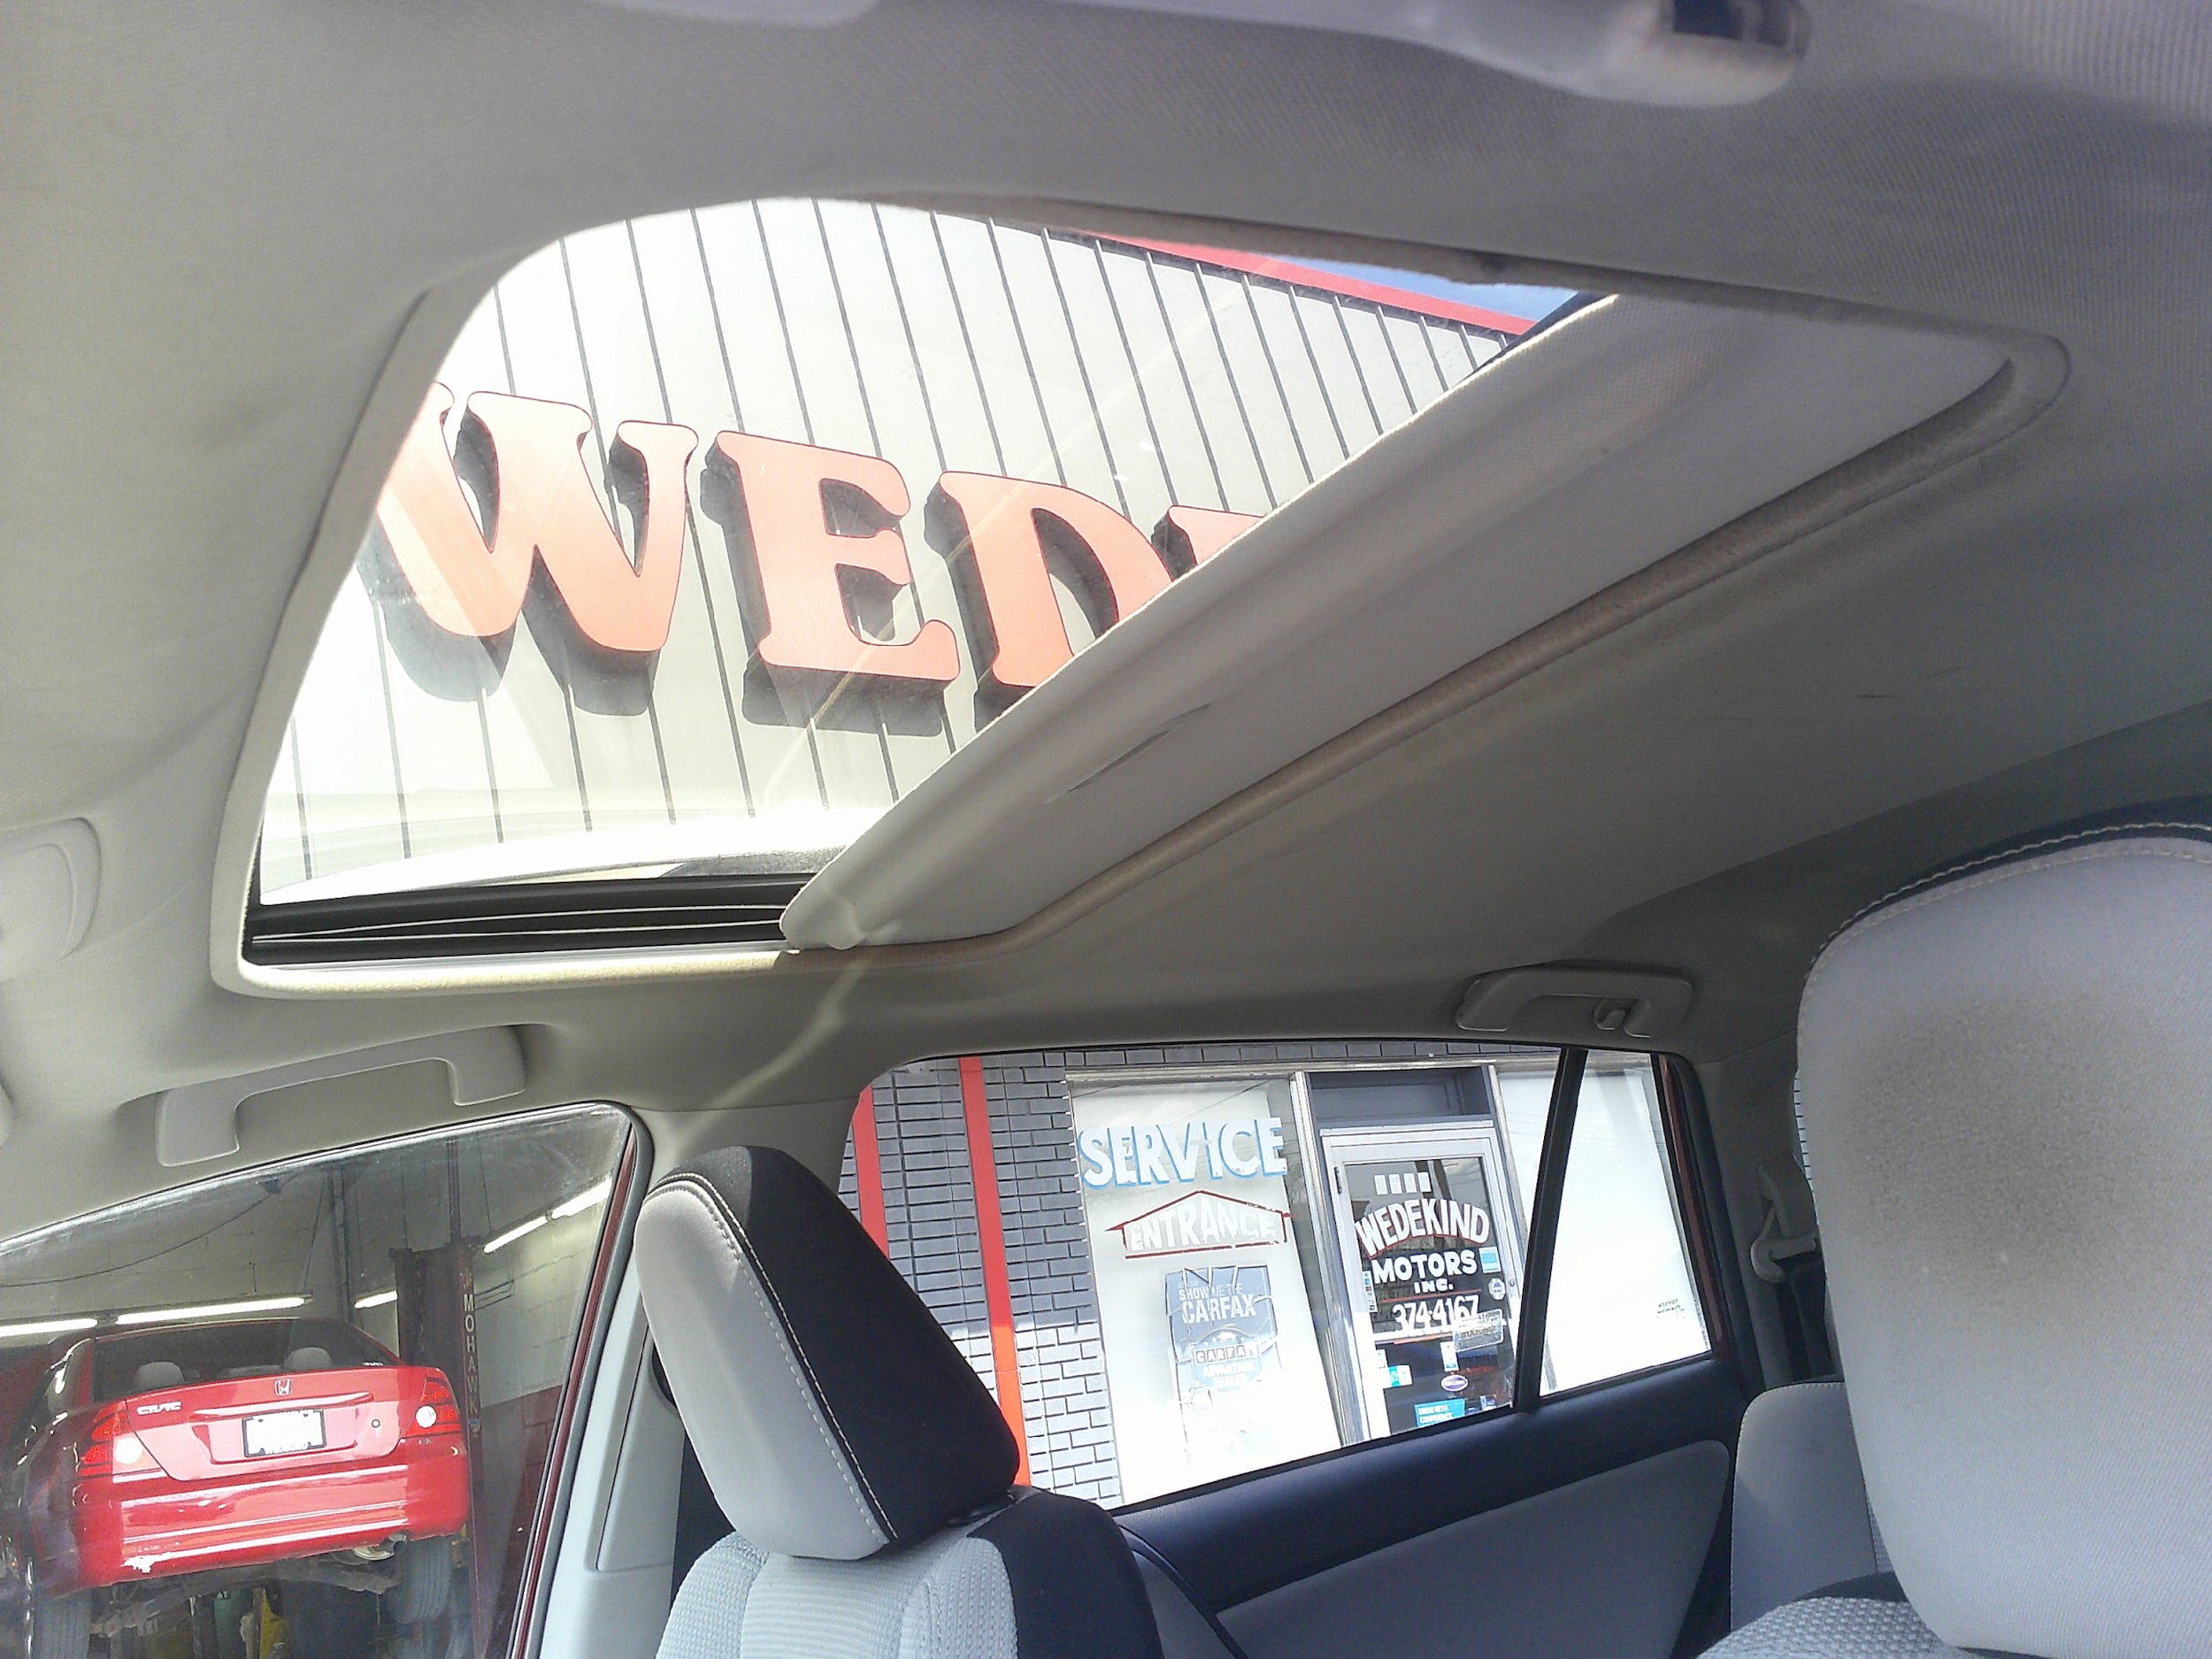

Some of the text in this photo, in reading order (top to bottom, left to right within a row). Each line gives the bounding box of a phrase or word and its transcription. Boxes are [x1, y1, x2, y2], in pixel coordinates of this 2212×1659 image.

[374, 382, 1263, 690] WED
[1076, 1118, 1288, 1189] SERVICE
[1130, 1196, 1277, 1252] ENTRANCE
[1355, 1198, 1489, 1256] WEDEKIND
[1179, 1286, 1210, 1301] SHOW
[1371, 1249, 1477, 1284] MOTORS
[1182, 1294, 1257, 1324] CARFAX
[464, 1294, 479, 1414] MOHAWK
